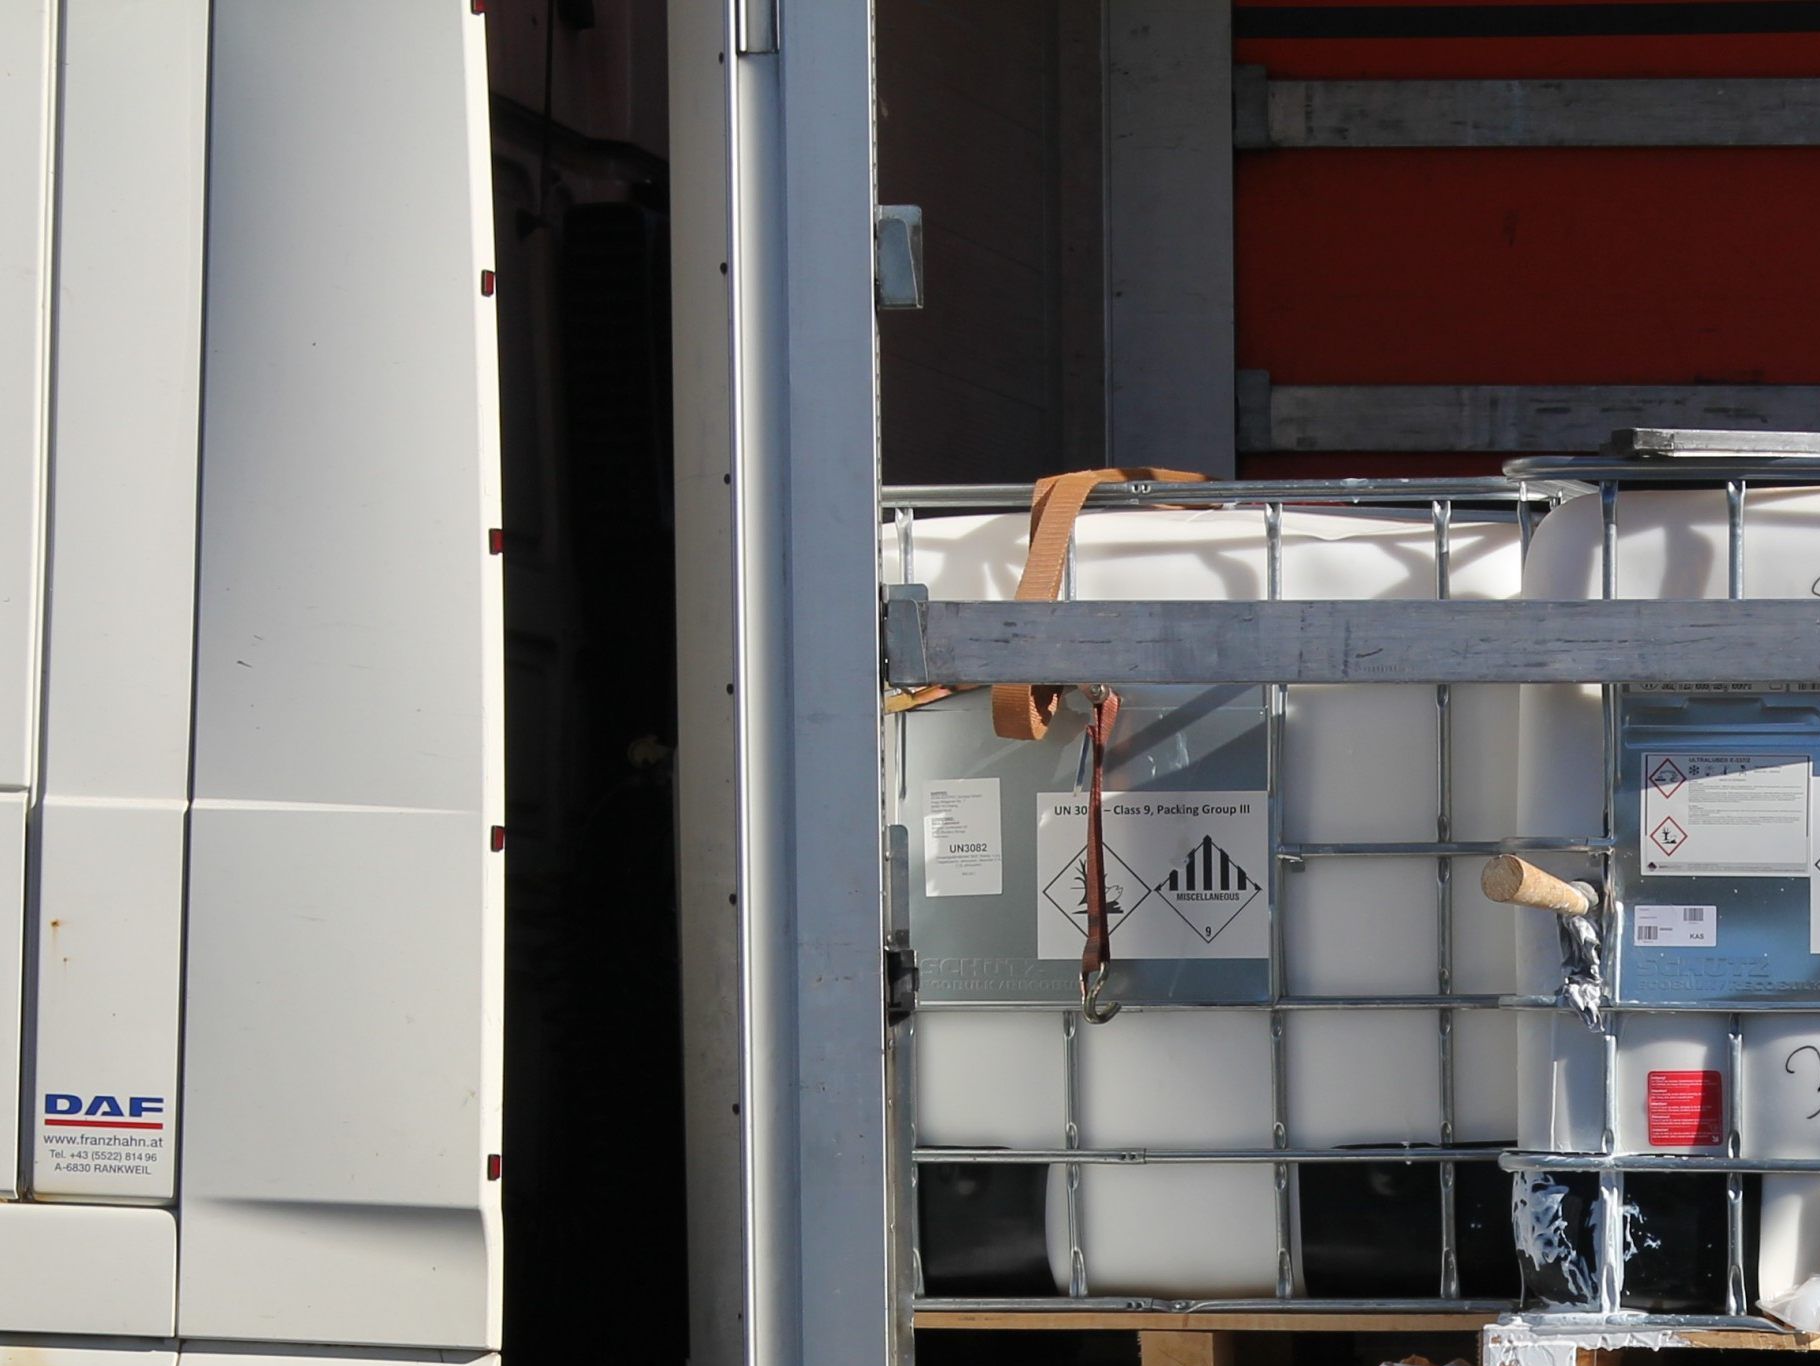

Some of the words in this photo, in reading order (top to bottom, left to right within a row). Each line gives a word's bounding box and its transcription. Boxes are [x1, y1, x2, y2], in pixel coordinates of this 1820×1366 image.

[1054, 806, 1072, 816] UN
[1113, 804, 1141, 815] Class
[1144, 805, 1153, 816] 9,
[1157, 804, 1199, 816] Packing
[1202, 804, 1237, 816] Group
[1239, 804, 1250, 814] III
[949, 843, 988, 853] UN3082
[1176, 892, 1240, 901] MISCELLANEOUS
[1205, 926, 1212, 937] 9
[44, 1093, 164, 1117] DAF
[43, 1134, 163, 1148] www.franzhahn.at
[50, 1150, 66, 1159] Tel.
[70, 1150, 89, 1160] +43
[91, 1151, 122, 1162] (5522)
[54, 1164, 91, 1173] A-6830
[94, 1165, 152, 1175] RANKWEIL
